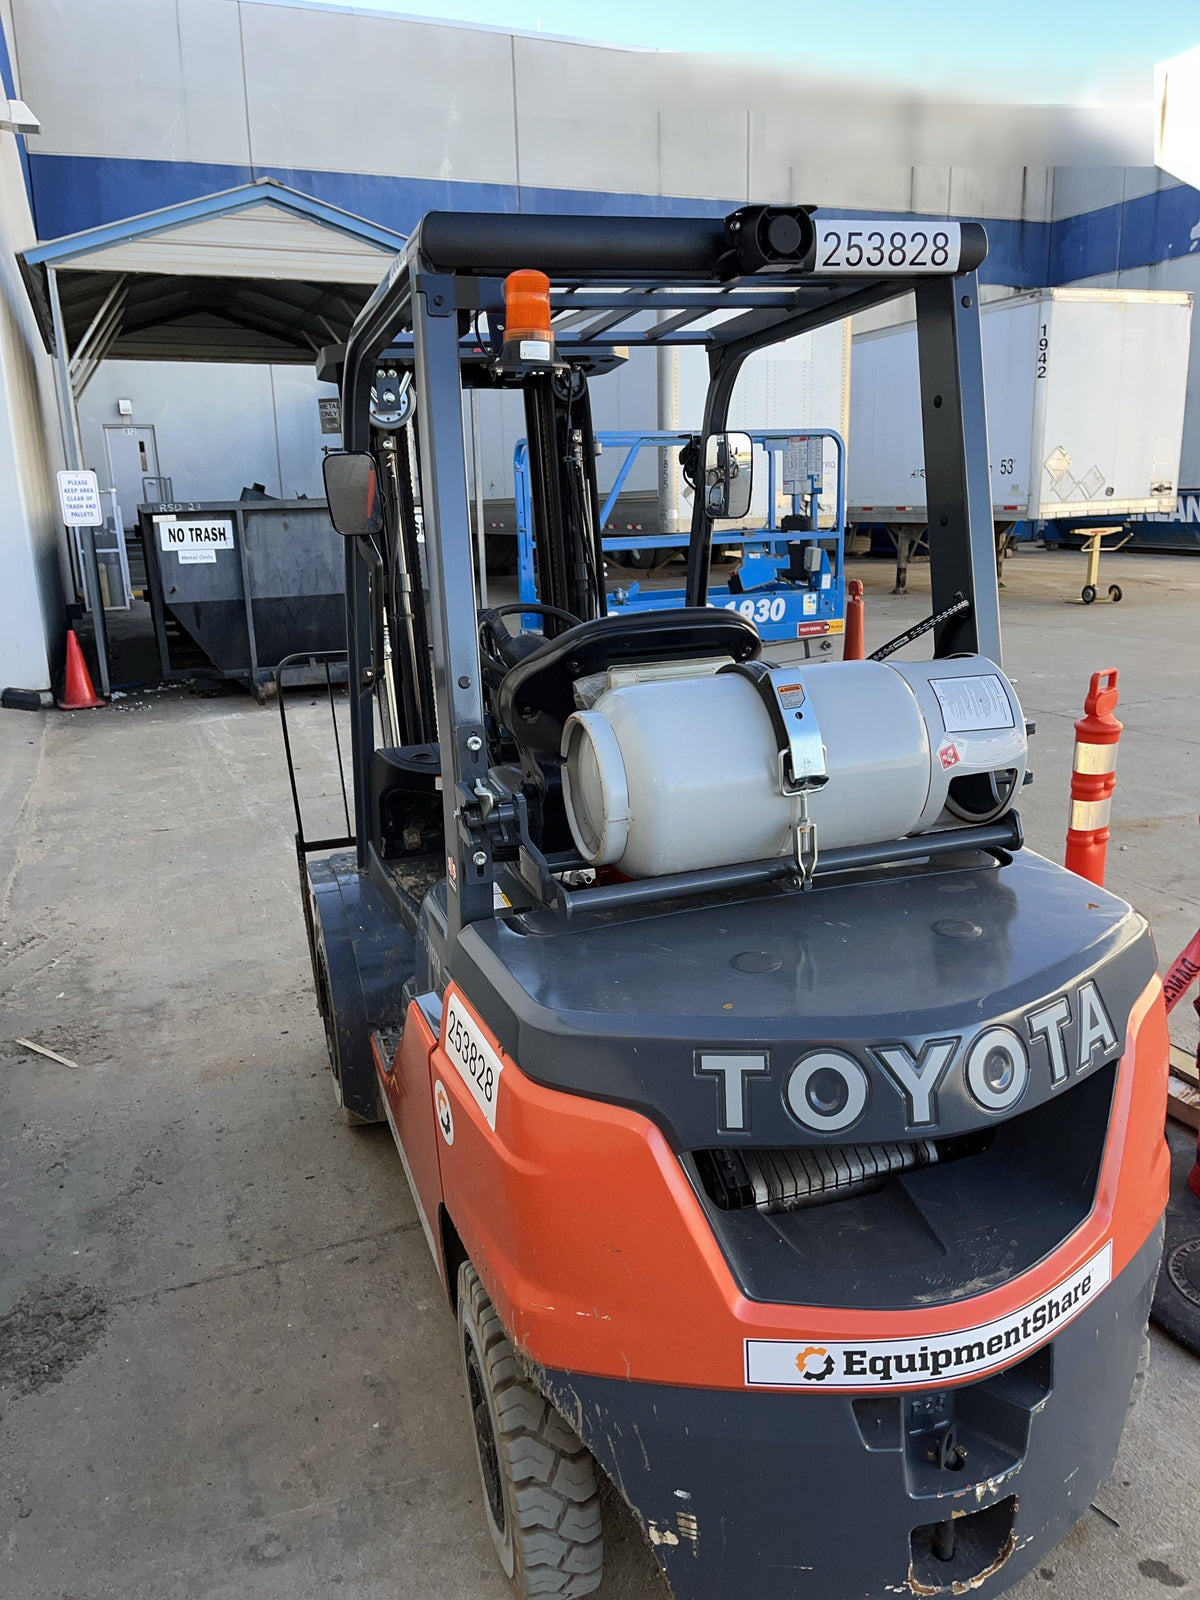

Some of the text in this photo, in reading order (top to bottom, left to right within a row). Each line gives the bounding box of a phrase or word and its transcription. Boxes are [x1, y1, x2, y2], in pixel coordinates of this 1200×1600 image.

[822, 231, 950, 267] 253828
[1037, 323, 1048, 379] 1942
[168, 527, 226, 543] NO TRASH
[447, 1010, 494, 1102] 253828
[696, 982, 1118, 1132] TOYOTA
[843, 1273, 1093, 1380] EquipmentShare
